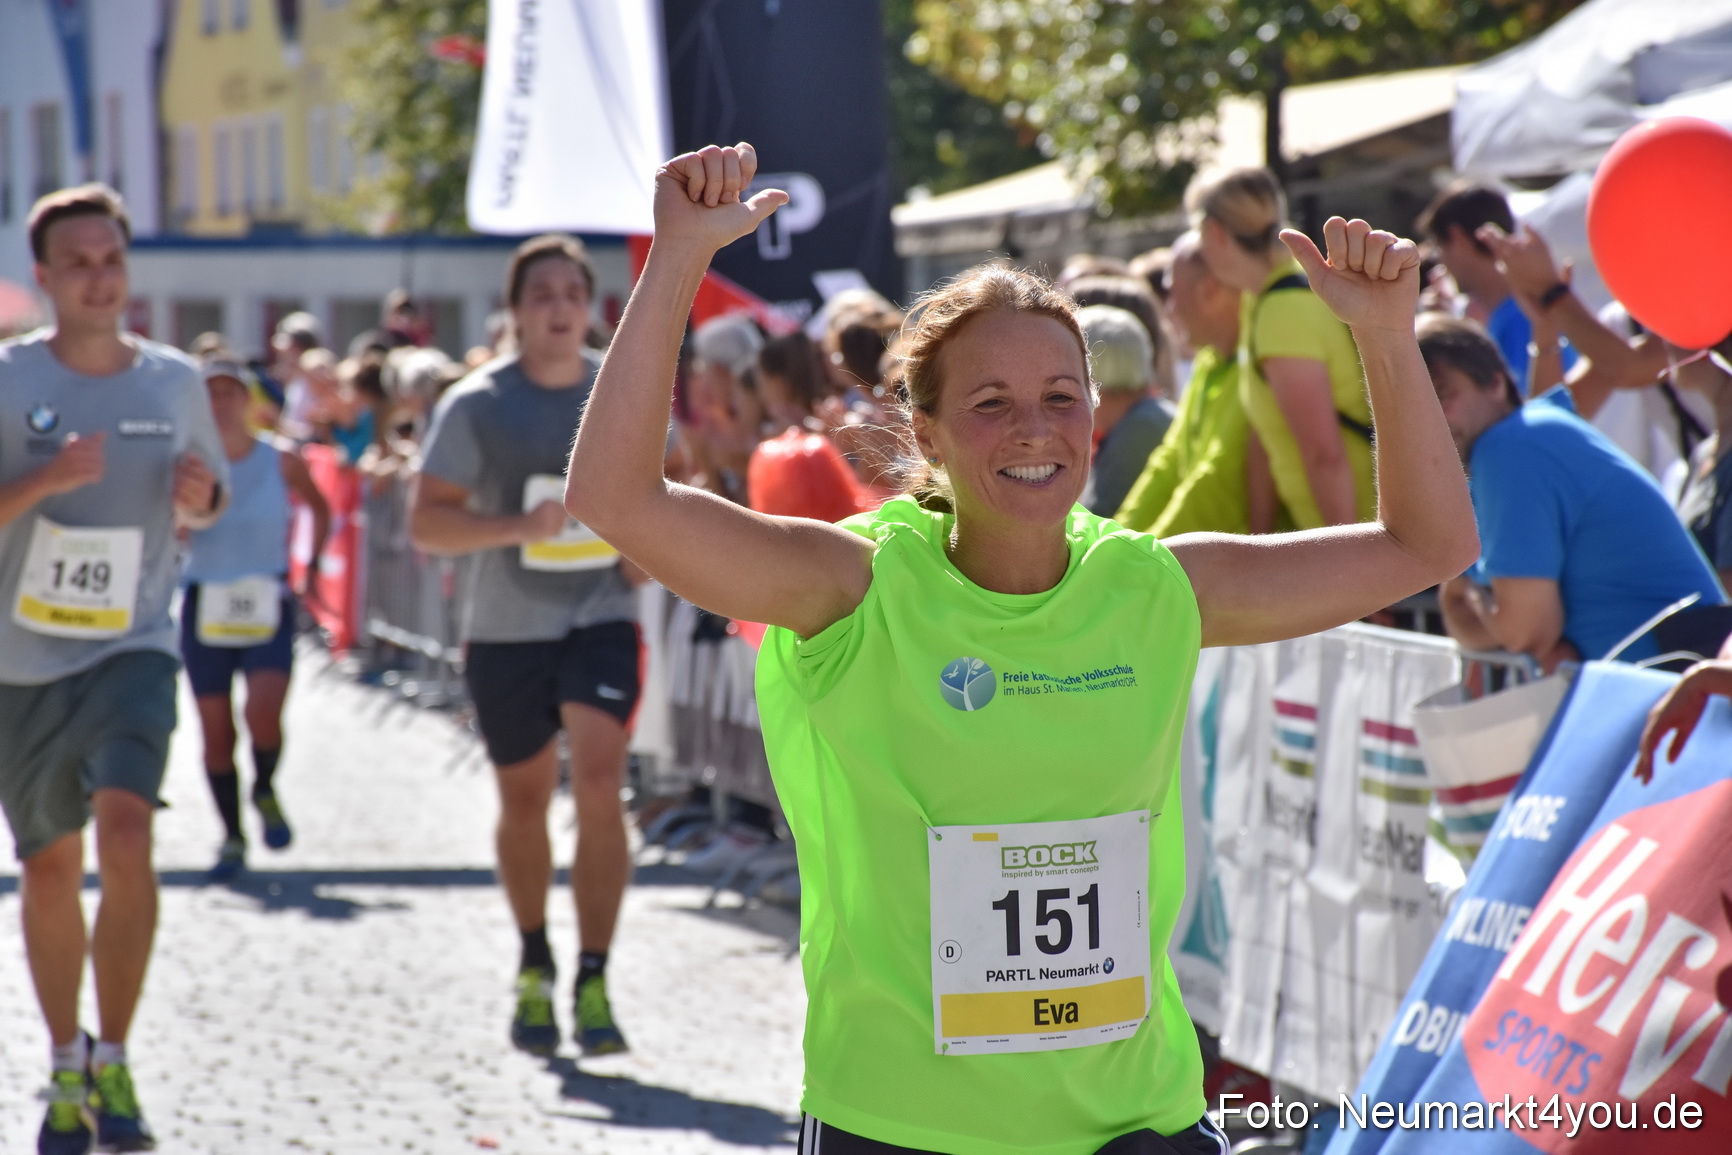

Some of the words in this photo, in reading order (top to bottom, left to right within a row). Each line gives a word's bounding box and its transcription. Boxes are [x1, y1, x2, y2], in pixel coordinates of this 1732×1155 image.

[52, 559, 112, 595] 149
[1003, 671, 1029, 682] Freie
[1082, 664, 1134, 682] Volksschule
[1003, 686, 1015, 696] im
[1018, 685, 1041, 695] Haus
[1043, 683, 1056, 694] St.
[1001, 840, 1099, 869] BOCK
[1001, 870, 1033, 879] inspired
[1034, 869, 1045, 877] by
[1046, 868, 1069, 876] smart
[1070, 864, 1100, 874] concepts
[992, 883, 1100, 957] 151
[986, 969, 1036, 982] PARTL
[1039, 963, 1100, 981] Neumarkt
[1033, 998, 1079, 1026] Eva
[1483, 1009, 1603, 1096] SPORTS
